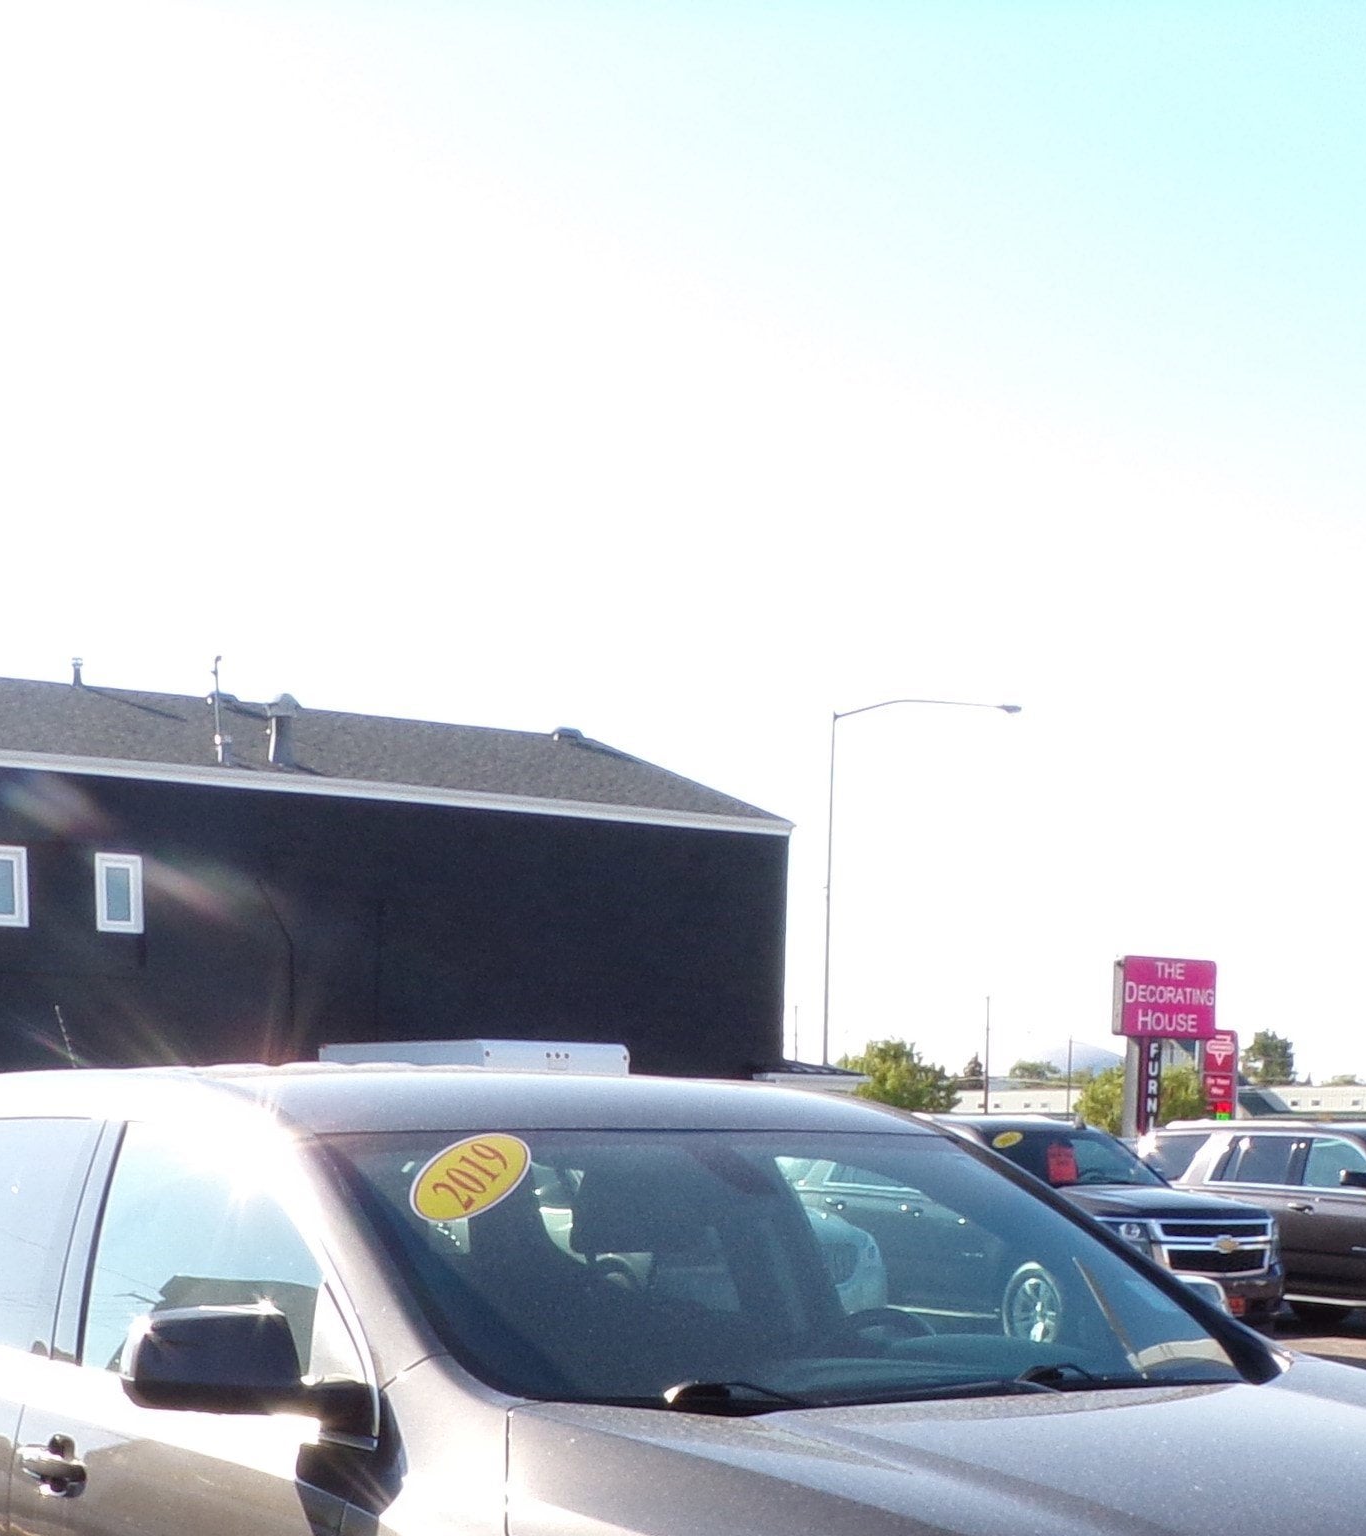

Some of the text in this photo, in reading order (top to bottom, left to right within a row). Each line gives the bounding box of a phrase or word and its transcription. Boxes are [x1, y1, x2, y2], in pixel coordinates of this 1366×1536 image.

[1155, 961, 1186, 980] THE
[1125, 981, 1215, 1006] DECORATING
[1137, 1009, 1198, 1032] HOUSE
[432, 1143, 508, 1211] 2019
